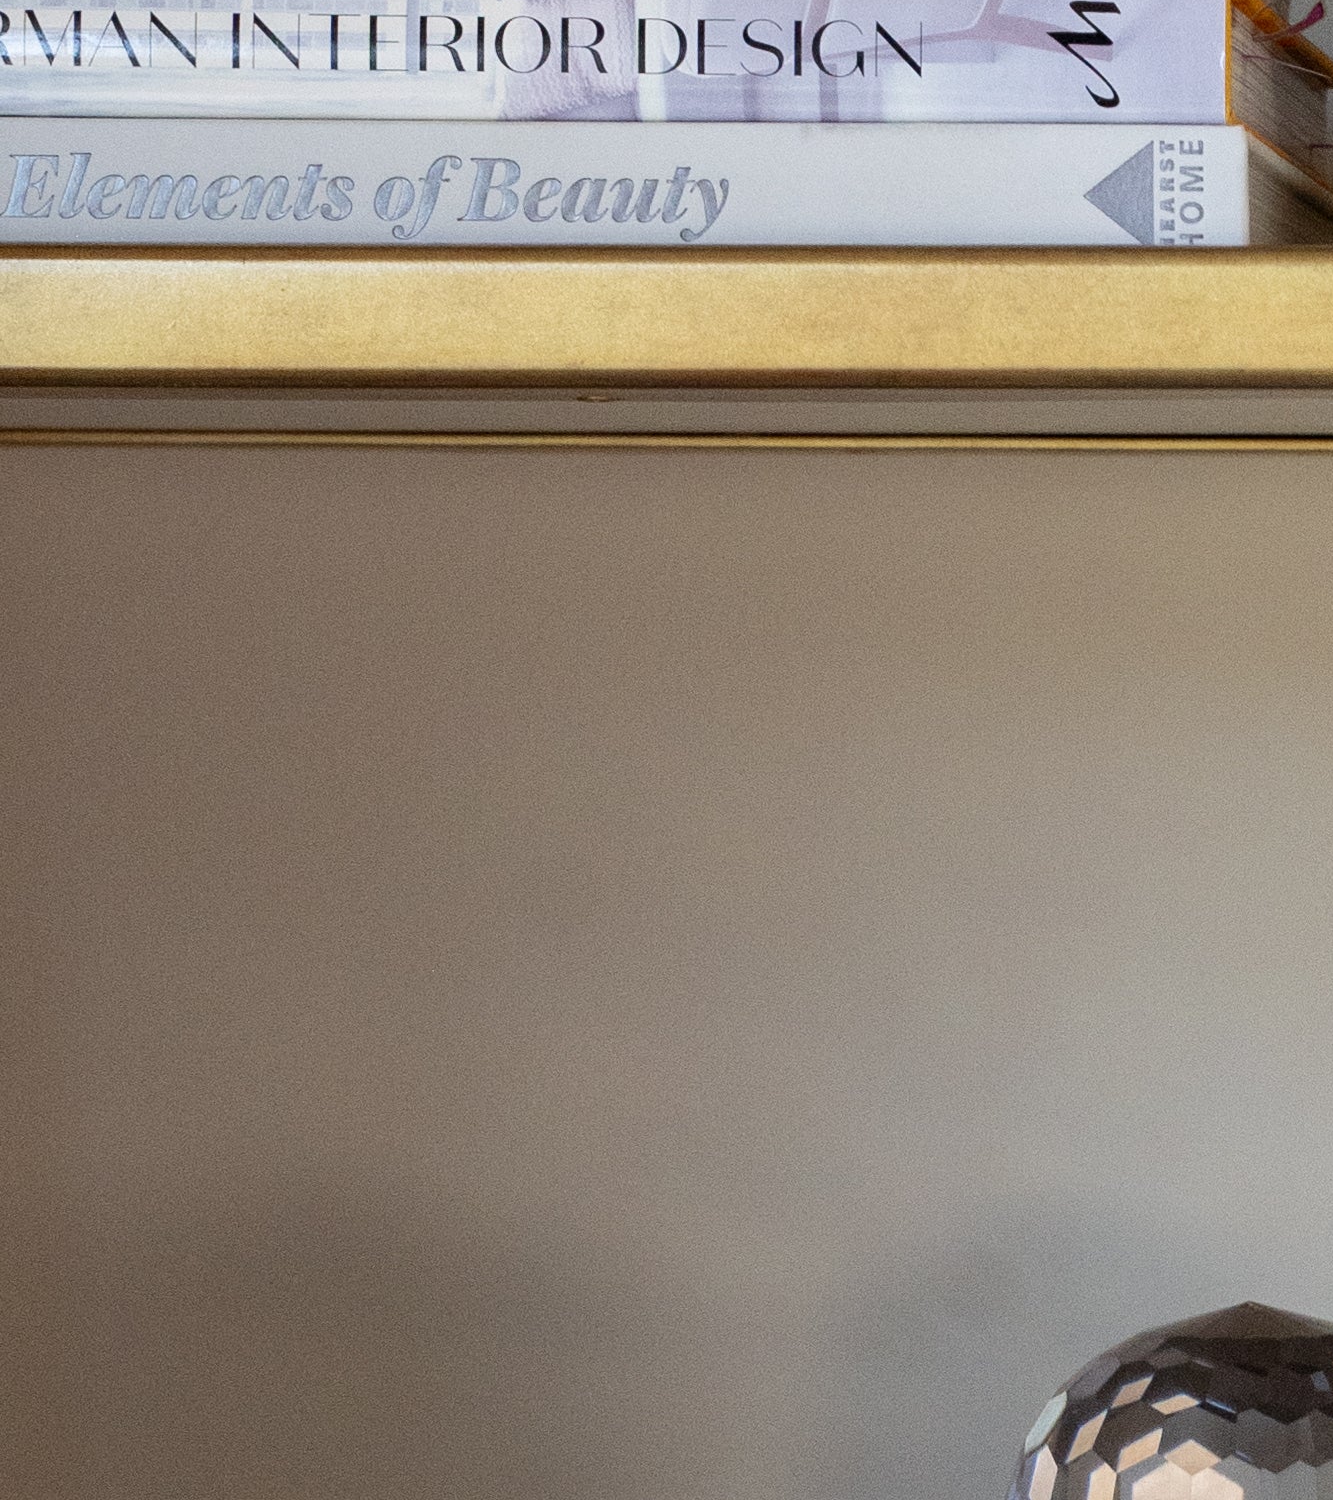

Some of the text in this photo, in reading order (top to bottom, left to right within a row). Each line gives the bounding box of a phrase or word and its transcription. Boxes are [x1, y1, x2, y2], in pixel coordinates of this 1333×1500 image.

[0, 9, 923, 78] MAN INTERIOR DESIGN
[7, 152, 729, 242] Elements of Beauty
